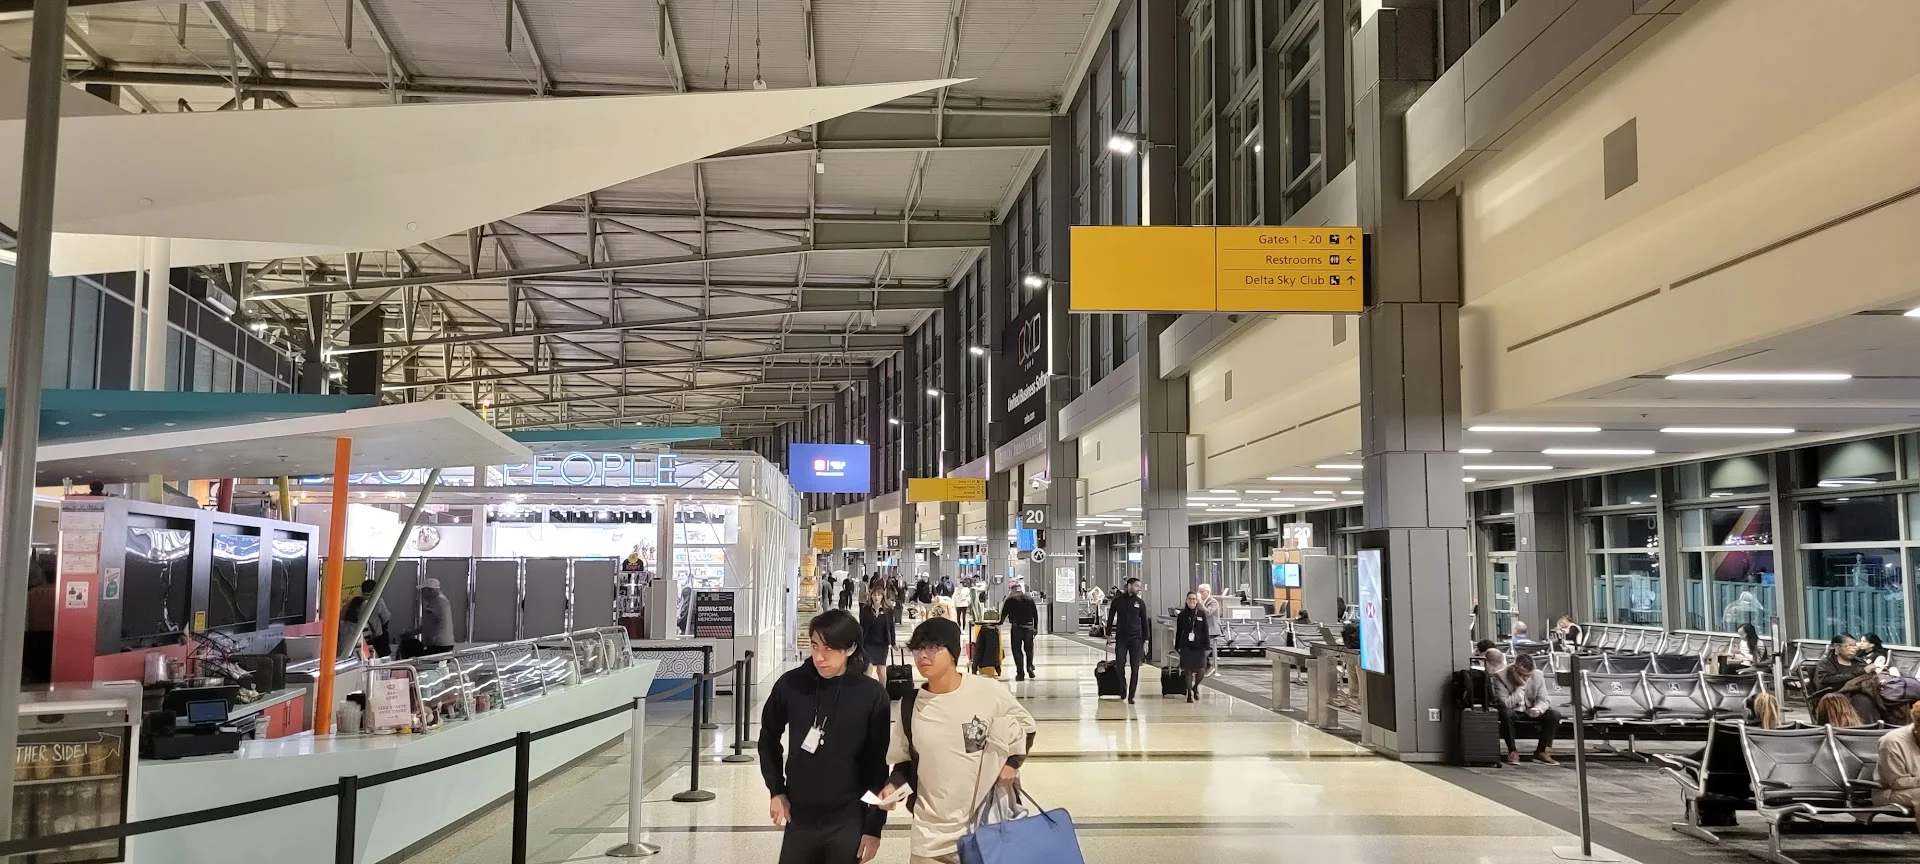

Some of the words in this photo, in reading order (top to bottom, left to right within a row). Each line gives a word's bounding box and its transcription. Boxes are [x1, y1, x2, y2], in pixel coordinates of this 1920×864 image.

[1258, 234, 1290, 245] Gates
[1292, 235, 1298, 245] 1
[1308, 235, 1322, 245] 20
[1265, 255, 1322, 265] Restrooms
[1245, 275, 1274, 285] Delta
[1277, 275, 1296, 287] Sky
[1300, 275, 1325, 285] Club
[1007, 389, 1021, 412] Unified
[1020, 381, 1036, 404] Business
[502, 453, 678, 487] PEOPLE
[1026, 509, 1044, 524] 20
[1294, 527, 1310, 539] 20
[889, 539, 899, 547] 19
